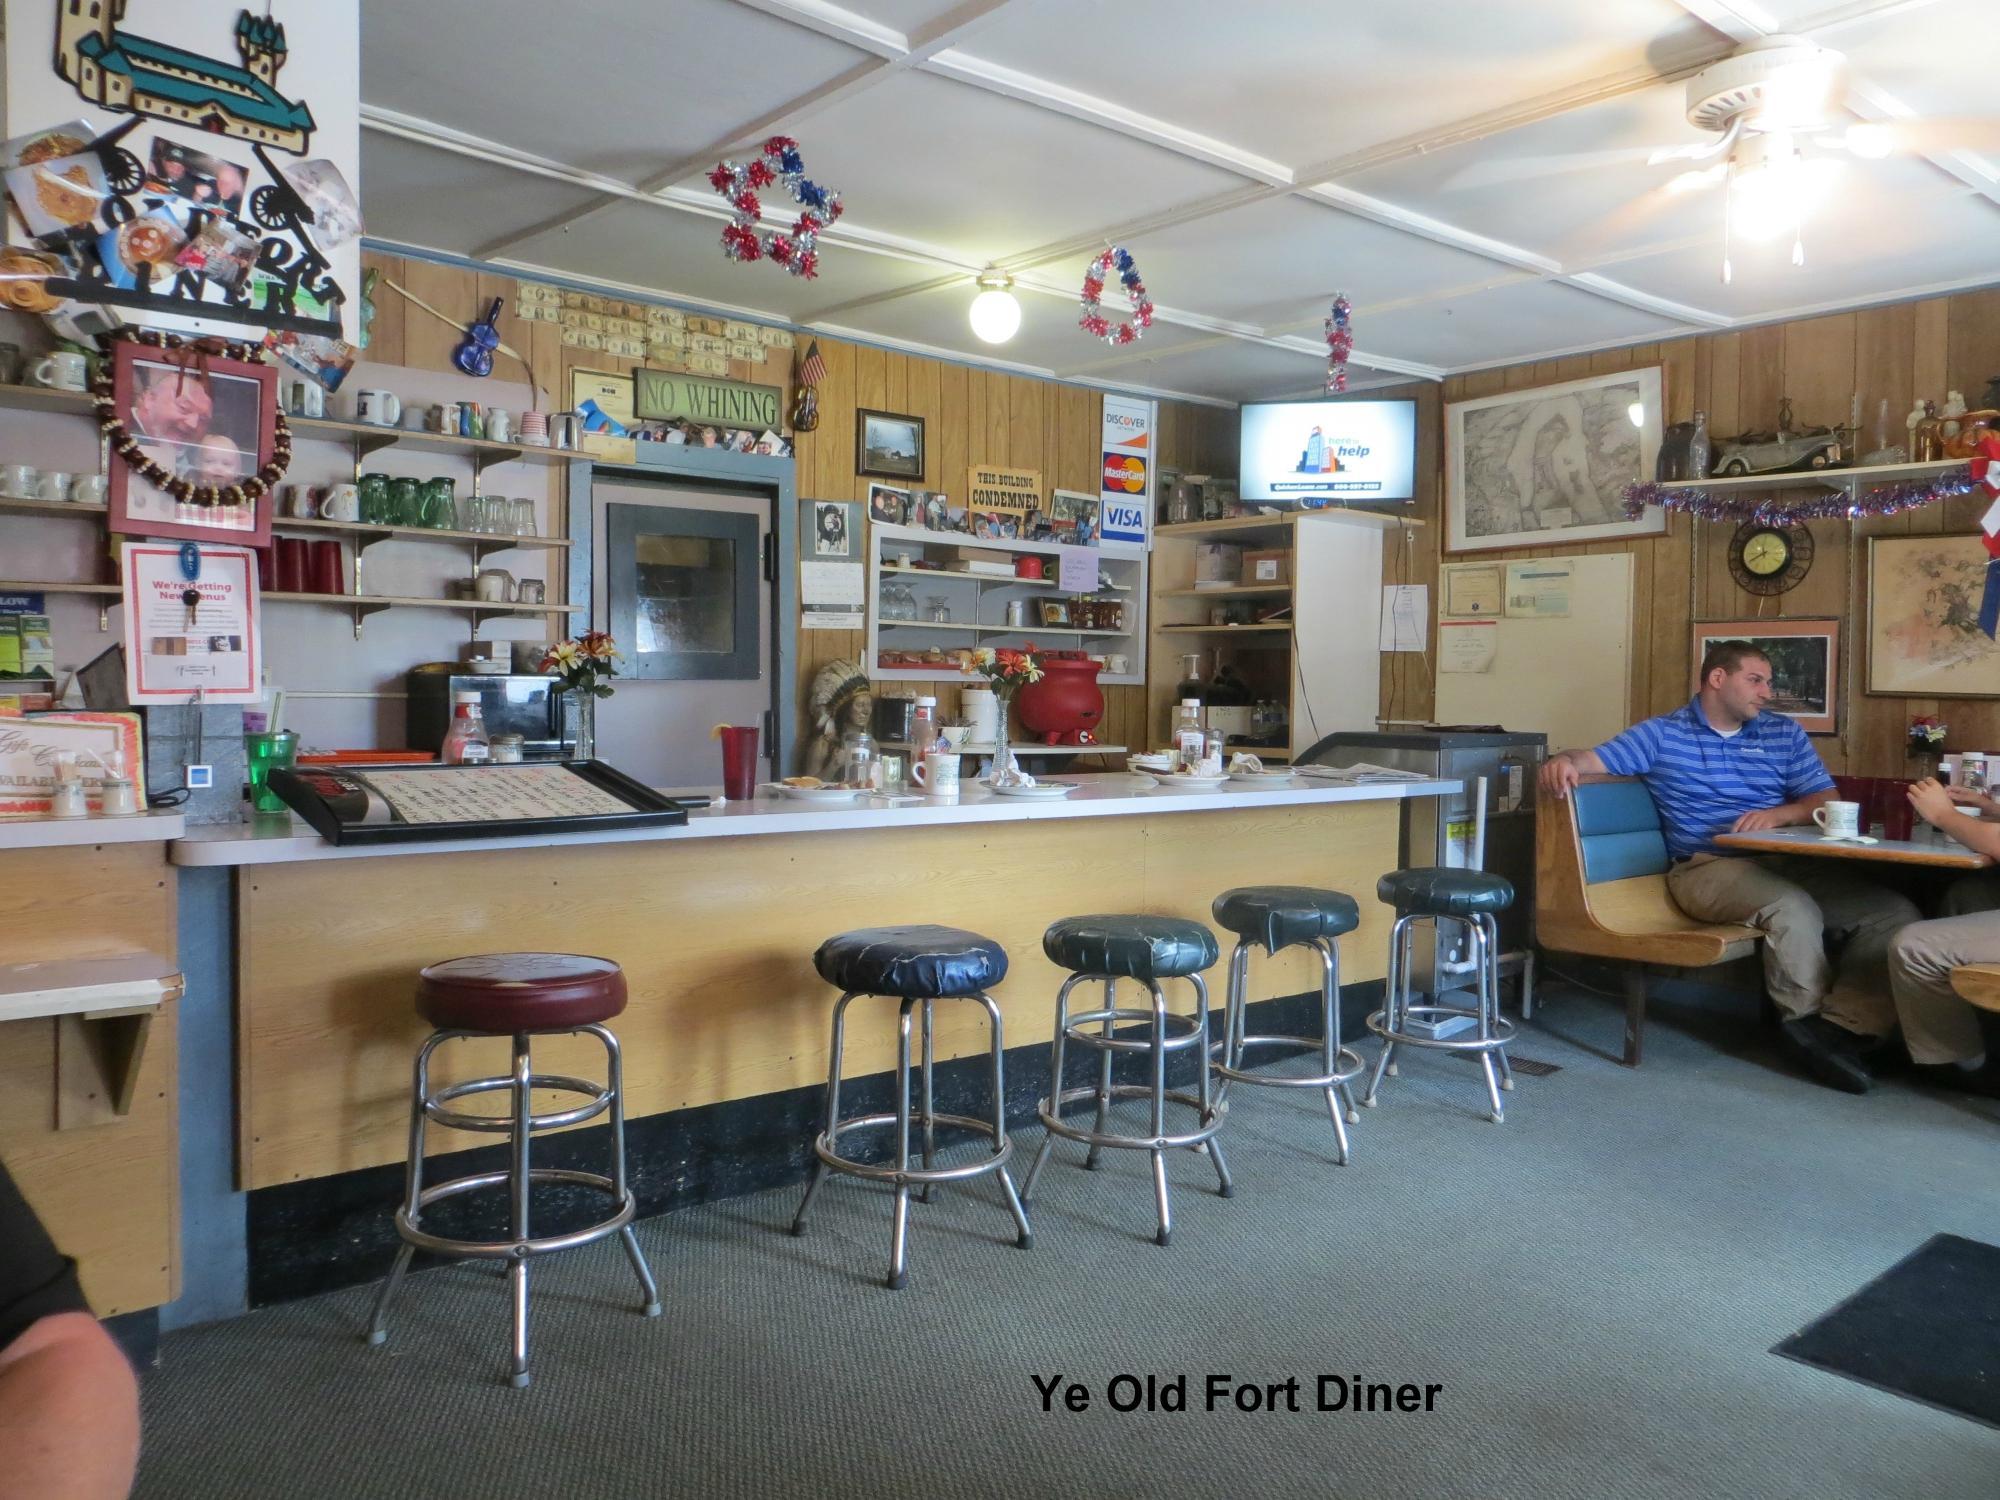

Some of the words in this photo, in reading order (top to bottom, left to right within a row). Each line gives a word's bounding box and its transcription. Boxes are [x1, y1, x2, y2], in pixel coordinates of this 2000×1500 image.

[644, 377, 675, 414] NO
[687, 382, 776, 426] WHINING
[1106, 413, 1145, 429] DISCOVER
[1337, 444, 1370, 458] help
[977, 472, 996, 485] THIS
[999, 474, 1034, 488] BUILDING
[1104, 466, 1145, 481] MasterCard
[973, 488, 1039, 510] CONDEMNED
[1107, 507, 1143, 529] VISA
[152, 580, 187, 591] We're
[188, 581, 232, 593] Getting
